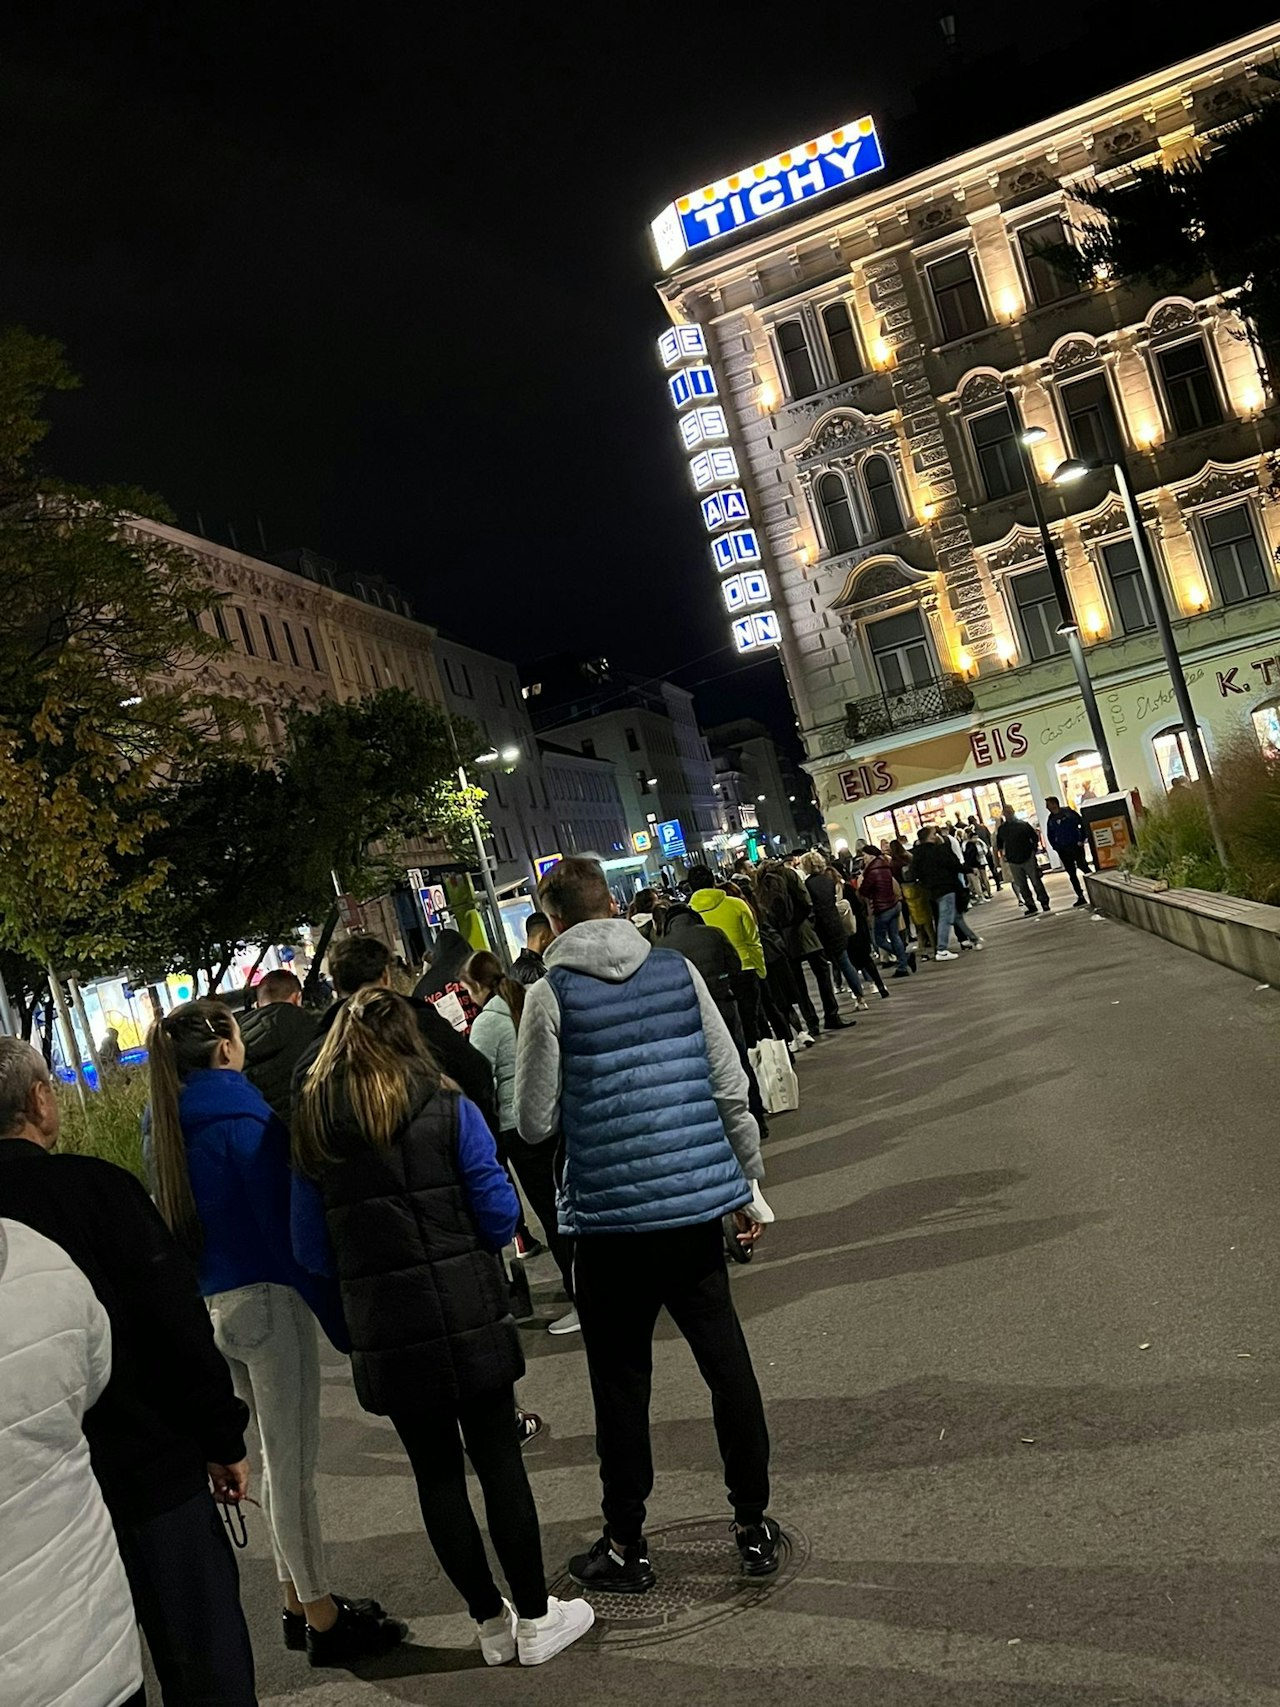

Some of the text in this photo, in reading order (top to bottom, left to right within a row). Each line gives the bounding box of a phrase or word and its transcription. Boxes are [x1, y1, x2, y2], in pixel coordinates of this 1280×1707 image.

[694, 141, 862, 236] TICHY
[1215, 666, 1251, 697] K.
[970, 722, 1028, 768] EIS
[838, 760, 895, 802] EIS
[525, 1419, 537, 1435] N
